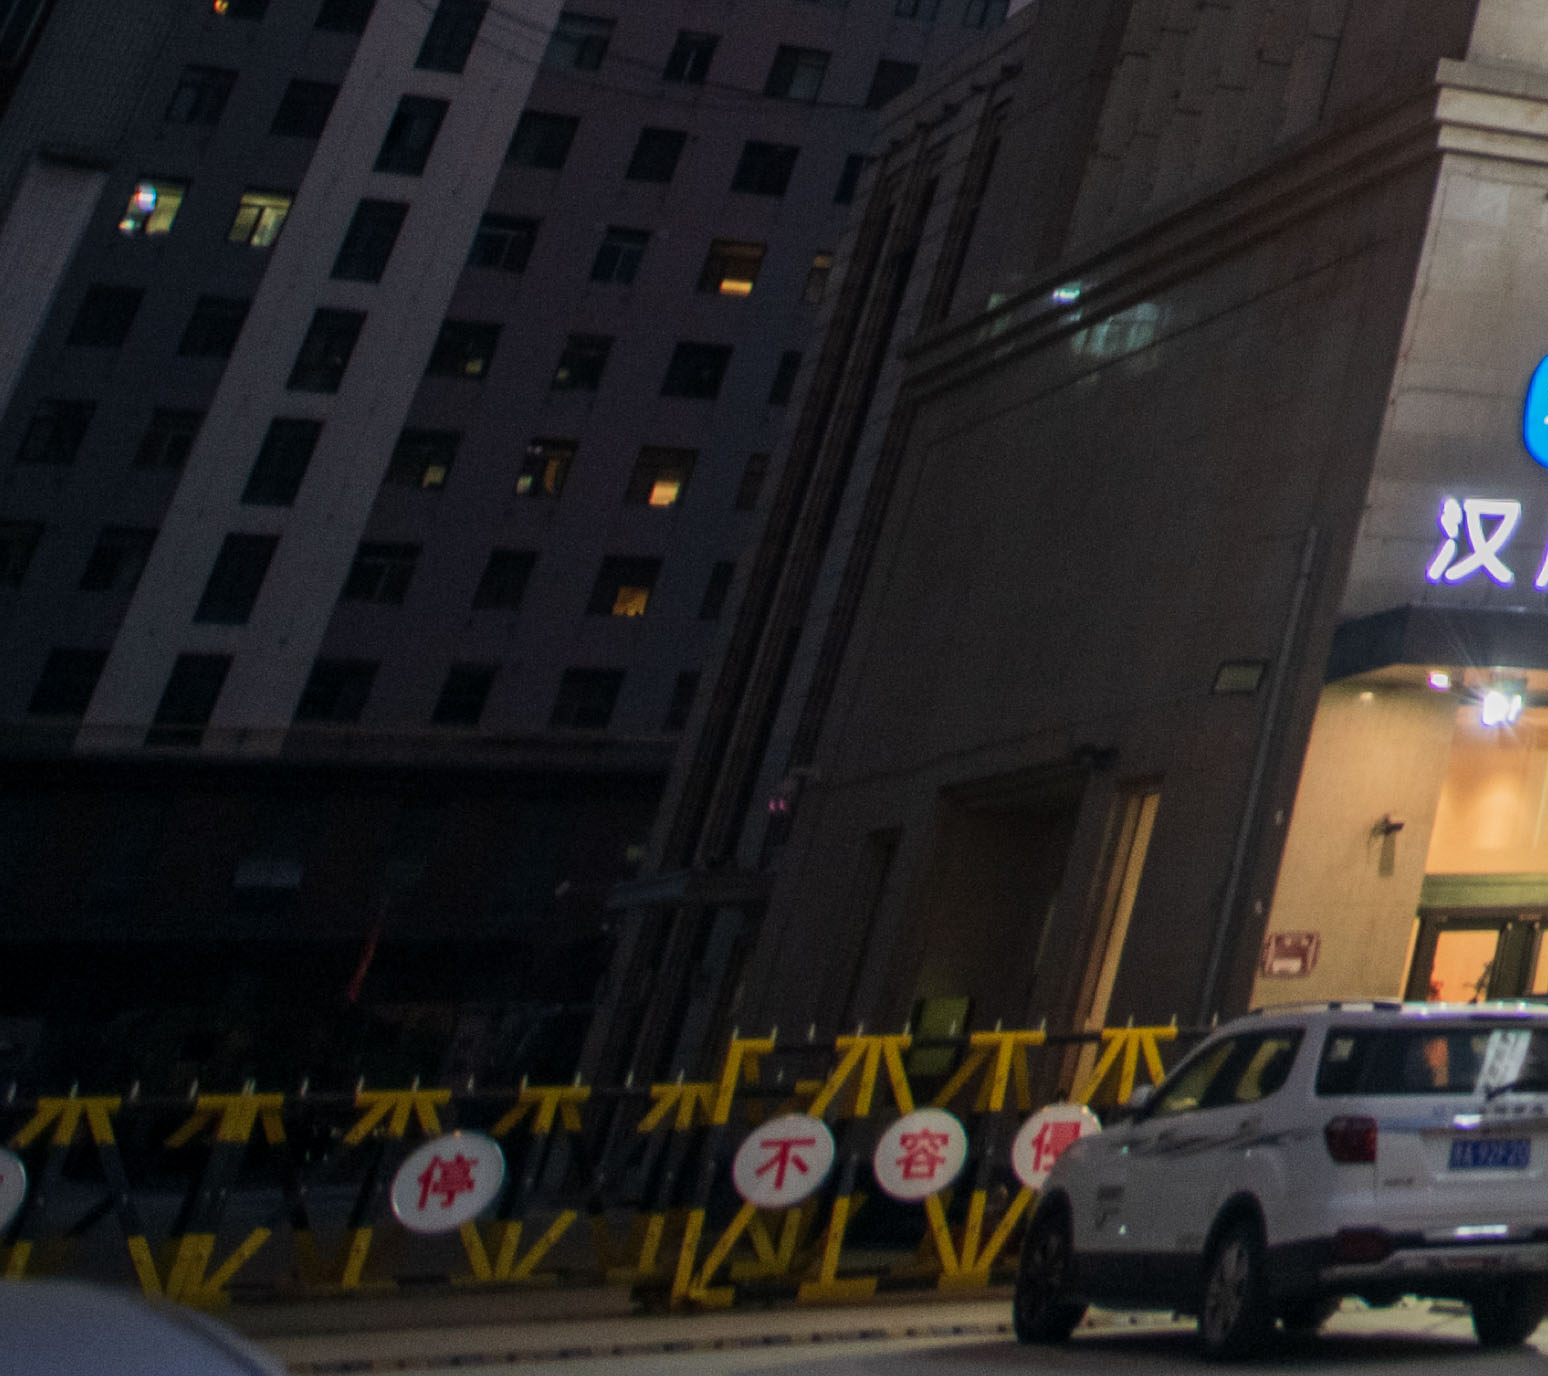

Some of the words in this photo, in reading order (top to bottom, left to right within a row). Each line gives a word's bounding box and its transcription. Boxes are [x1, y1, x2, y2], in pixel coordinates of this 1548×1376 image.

[414, 1152, 478, 1210] 停
[755, 1135, 818, 1190] 不
[896, 1125, 952, 1181] 容
